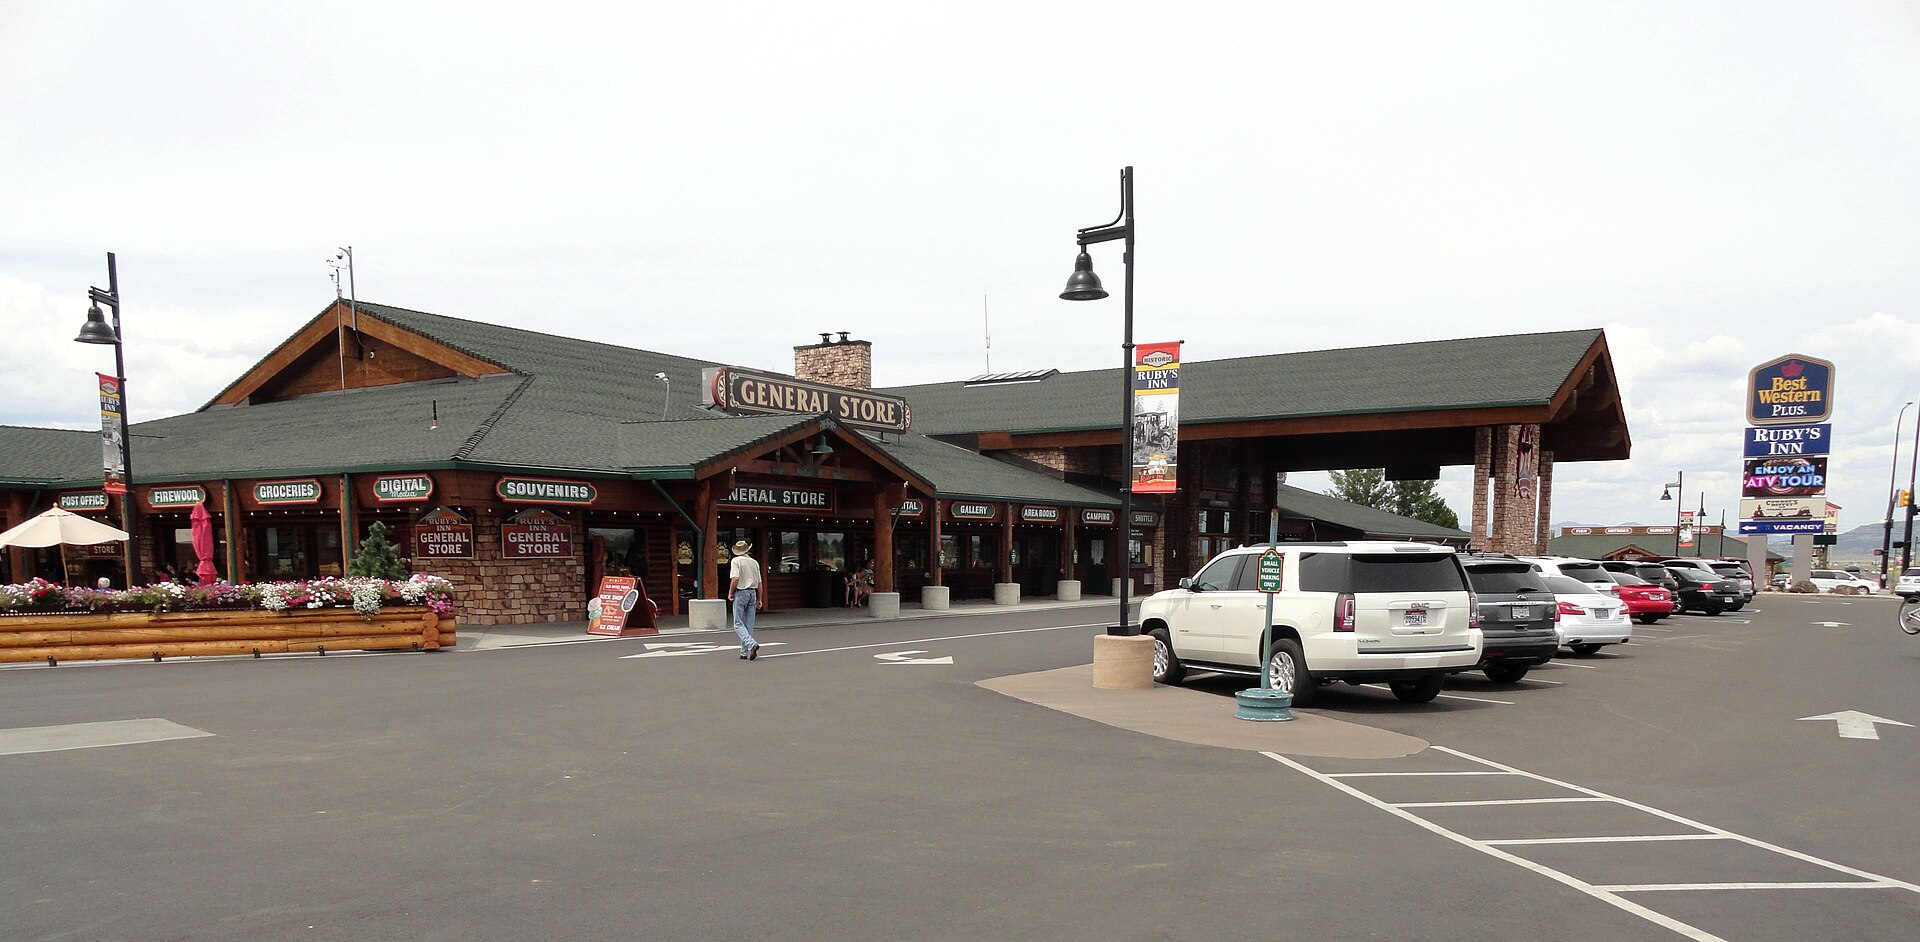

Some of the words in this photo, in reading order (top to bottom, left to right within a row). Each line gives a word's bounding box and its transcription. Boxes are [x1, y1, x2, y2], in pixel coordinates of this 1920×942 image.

[1143, 355, 1172, 363] HISTORIC
[1137, 369, 1178, 380] RUBY'S
[1147, 379, 1168, 389] INN
[1771, 376, 1807, 391] Best
[740, 380, 832, 413] GENERAL
[839, 395, 896, 424] STORE
[1758, 389, 1821, 404] Western
[104, 403, 116, 412] INN
[1753, 427, 1821, 442] RUBY'S
[1768, 441, 1804, 455] INN
[1755, 465, 1795, 475] ENJOY
[1797, 465, 1816, 474] AN
[380, 478, 426, 492] DIGITAL
[1745, 475, 1778, 488] ATV
[1779, 475, 1824, 487] TOUR
[259, 484, 314, 499] GROCERIES
[389, 490, 418, 498] Media
[506, 482, 589, 498] SOUVENIRS
[61, 496, 80, 506] POST
[80, 494, 105, 506] OFFICE
[154, 489, 198, 503] FIREWOOD
[720, 488, 777, 503] NERAL
[783, 490, 825, 505] STORE
[960, 505, 988, 515] GALLERY
[1023, 509, 1038, 517] AREA
[1038, 509, 1056, 518] BOOKS
[1086, 512, 1110, 521] CAMPING
[1135, 515, 1153, 523] SHUTTLE
[420, 533, 469, 543] GENERAL
[508, 533, 568, 543] GENERAL
[93, 545, 116, 554] STORE
[428, 544, 463, 554] STORE
[518, 543, 560, 554] STORE
